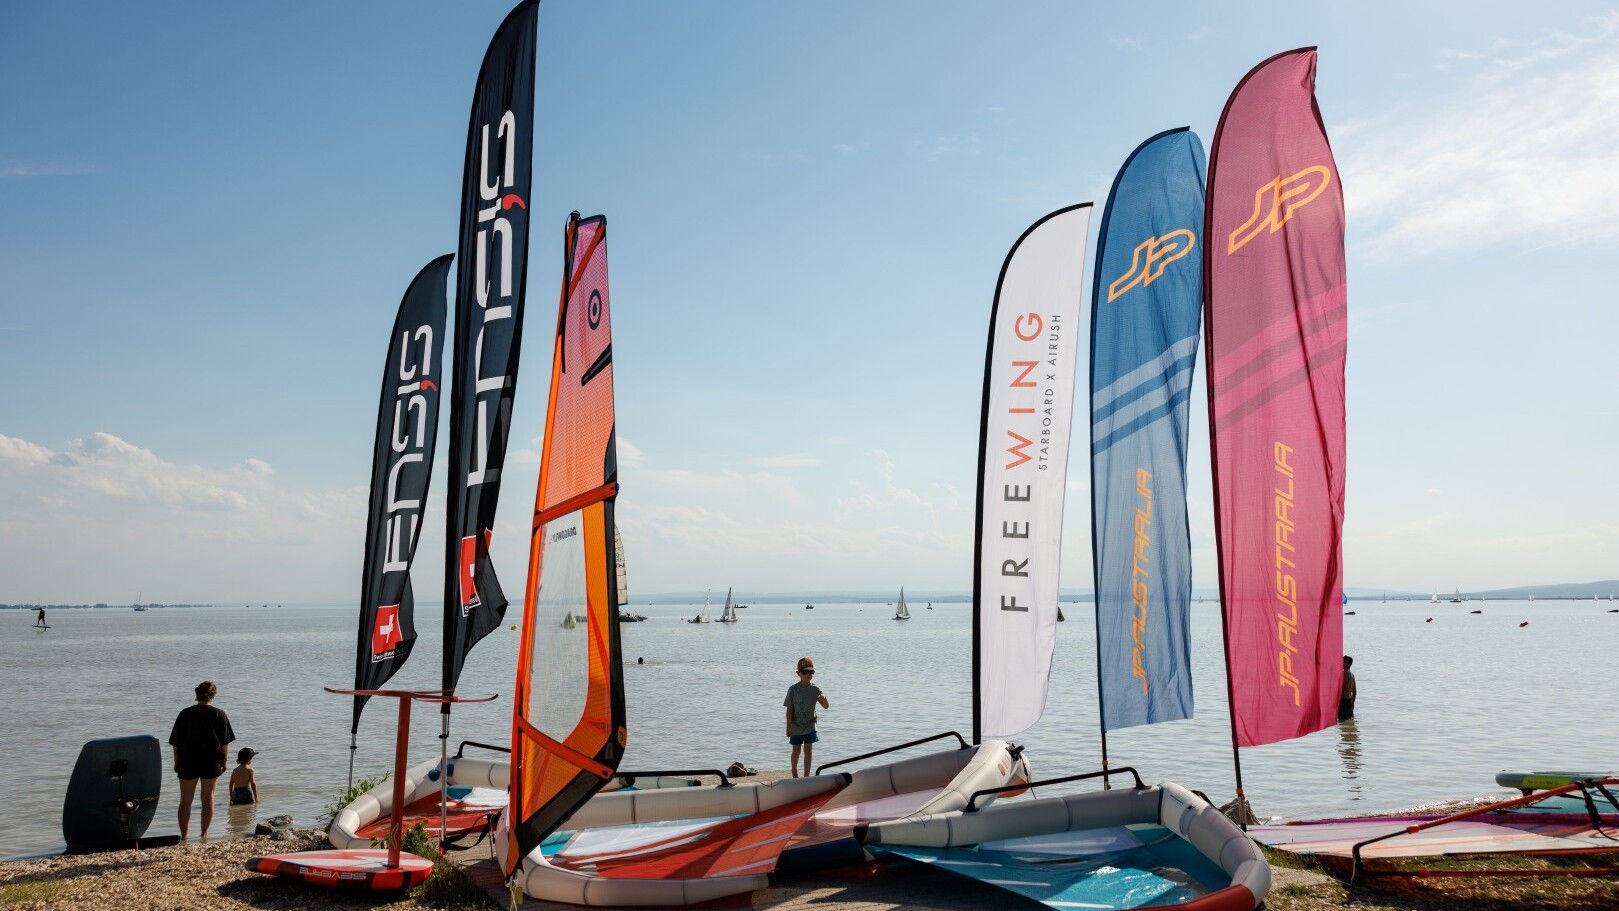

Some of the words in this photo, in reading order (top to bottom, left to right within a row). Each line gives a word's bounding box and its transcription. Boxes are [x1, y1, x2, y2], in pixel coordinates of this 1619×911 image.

[1227, 163, 1332, 255] JP
[1107, 228, 1196, 303] JP
[1039, 388, 1054, 470] STARBOARD
[1048, 315, 1061, 366] AIRUSH
